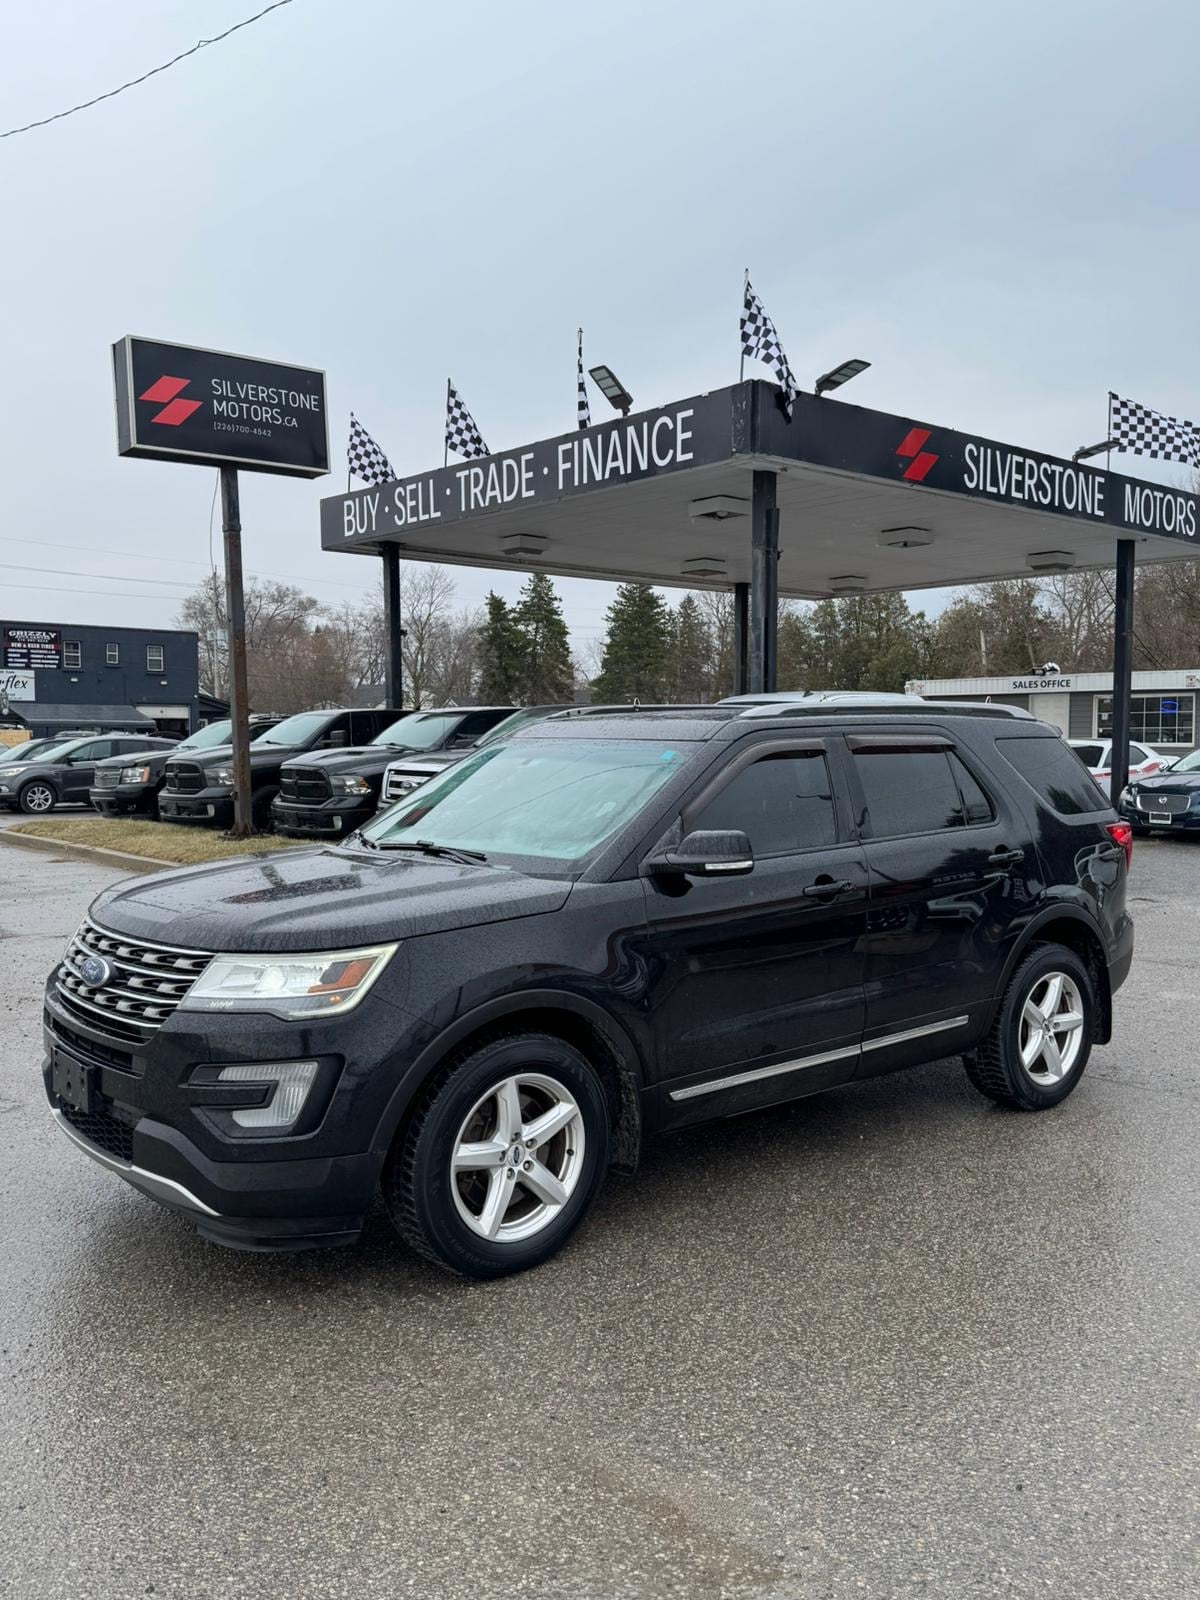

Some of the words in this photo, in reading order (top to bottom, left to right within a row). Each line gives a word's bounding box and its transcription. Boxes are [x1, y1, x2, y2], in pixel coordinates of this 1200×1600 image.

[211, 378, 320, 412] SILVERSTONE
[213, 399, 298, 428] MOTORS.CA
[213, 421, 272, 437] (226)700-4542
[343, 493, 380, 537] BUY
[394, 479, 441, 526] SELL
[456, 452, 535, 512] TRADE
[558, 409, 694, 490] FINANCE
[963, 443, 1105, 517] SILVERSTONE
[1124, 483, 1196, 537] MOTORS
[8, 630, 57, 639] GRIZZLY
[1012, 680, 1039, 689] SALES
[1040, 679, 1071, 688] OFFICE
